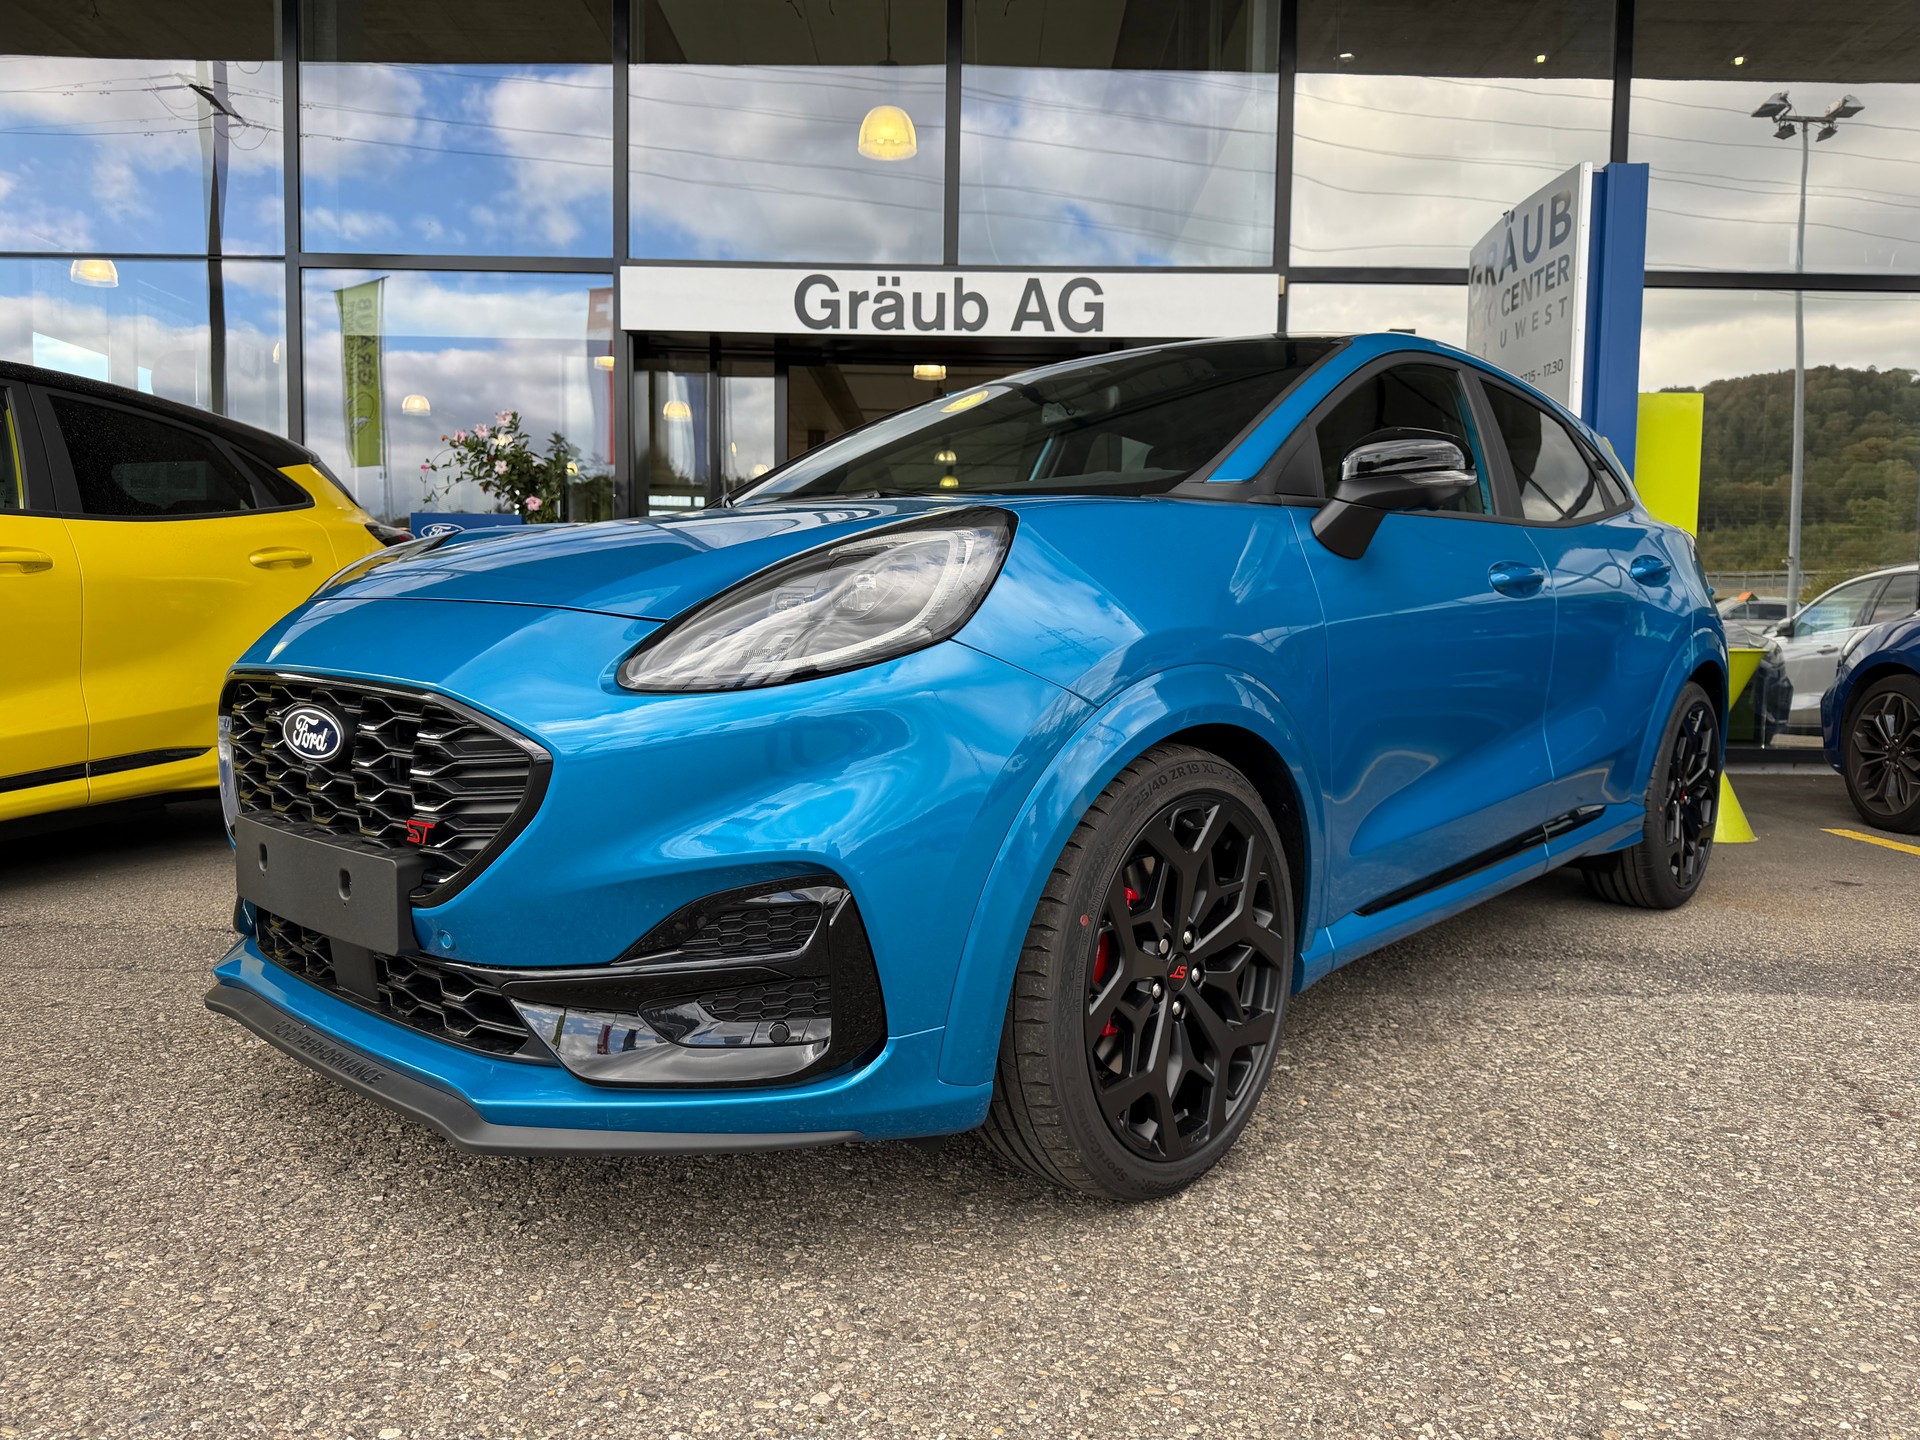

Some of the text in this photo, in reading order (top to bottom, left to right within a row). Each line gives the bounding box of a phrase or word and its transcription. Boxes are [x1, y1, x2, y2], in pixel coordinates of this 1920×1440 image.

[794, 273, 1105, 333] Gräub AG
[292, 714, 329, 752] Ford
[406, 819, 435, 845] ST
[271, 1020, 387, 1085] FORD PERFORMANCE
